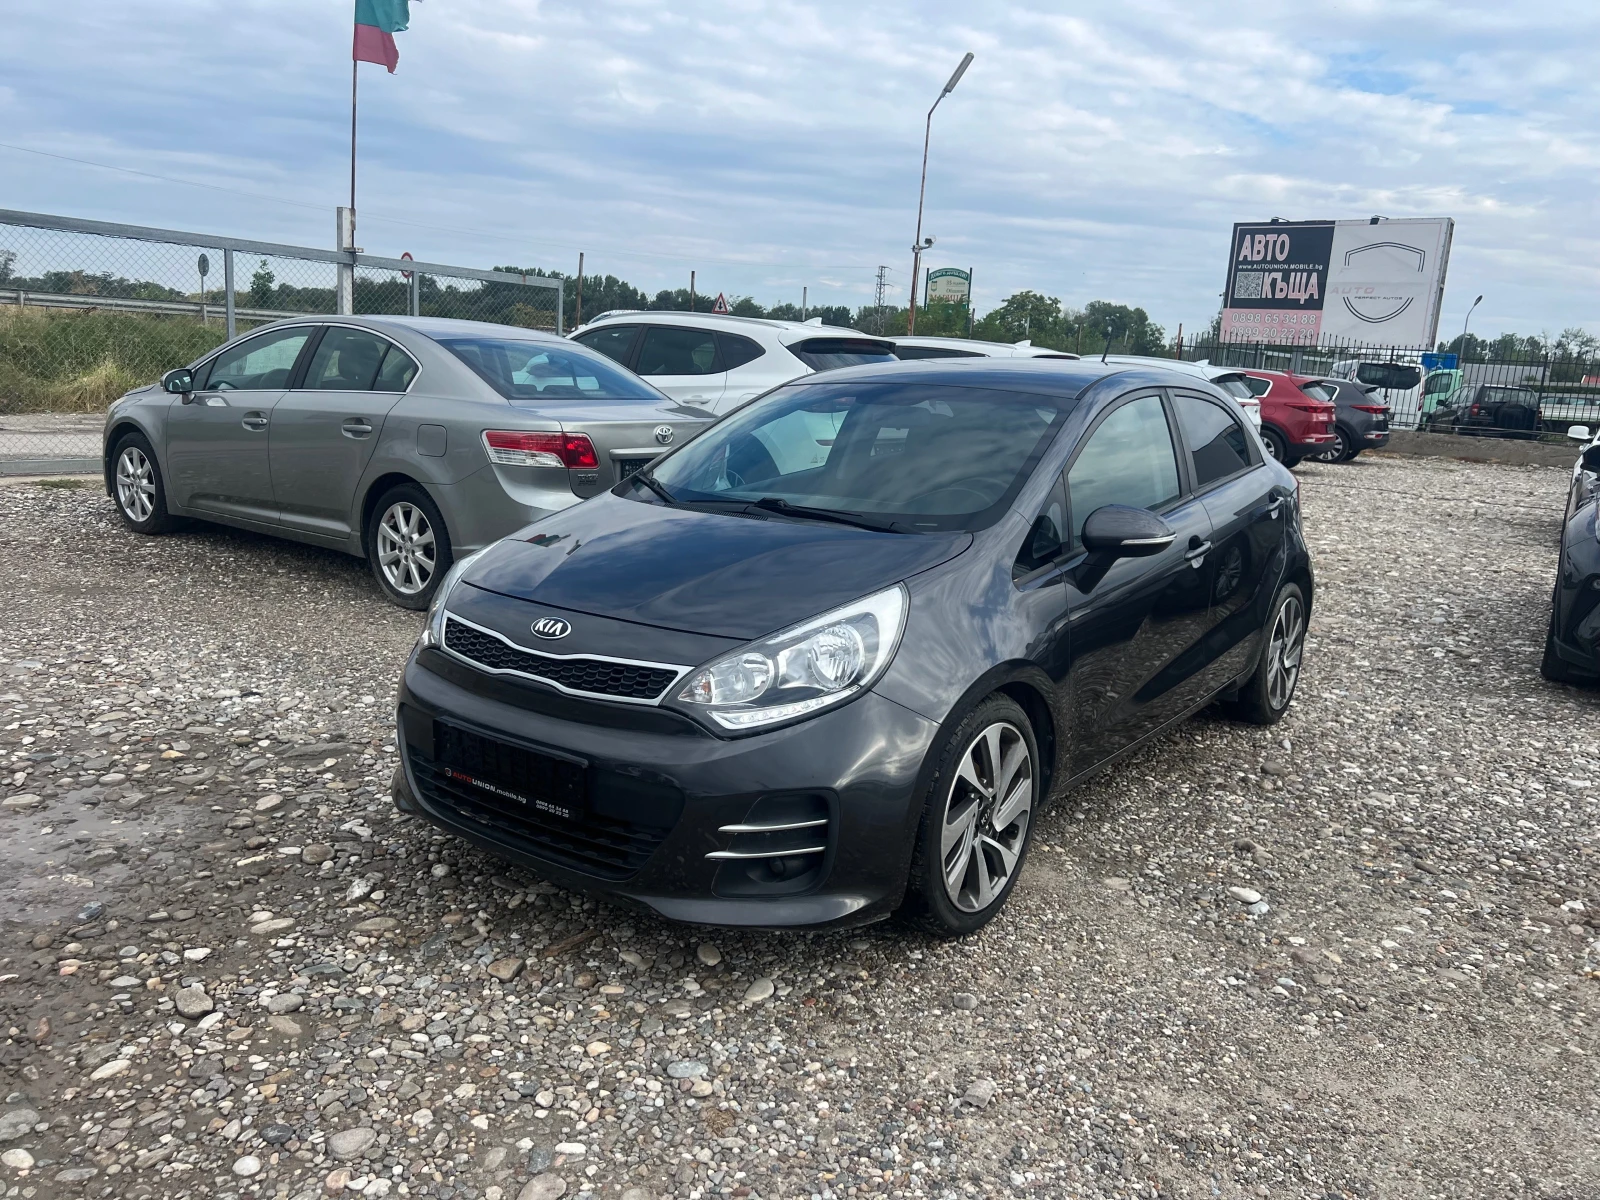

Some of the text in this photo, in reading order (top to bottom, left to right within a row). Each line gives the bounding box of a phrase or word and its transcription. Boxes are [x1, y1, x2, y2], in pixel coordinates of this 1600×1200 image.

[1238, 233, 1290, 261] АВТО
[1238, 263, 1323, 271] www.AUTOUNION.MOBILE.bg
[1261, 272, 1319, 304] КЪЩА
[1330, 286, 1375, 294] AUTO
[1231, 312, 1316, 325] 0898 65 34 88
[1230, 326, 1314, 339] 0899 20 22 20
[534, 618, 563, 636] KIA
[452, 771, 527, 804] AUTOUNION.mobile.bg
